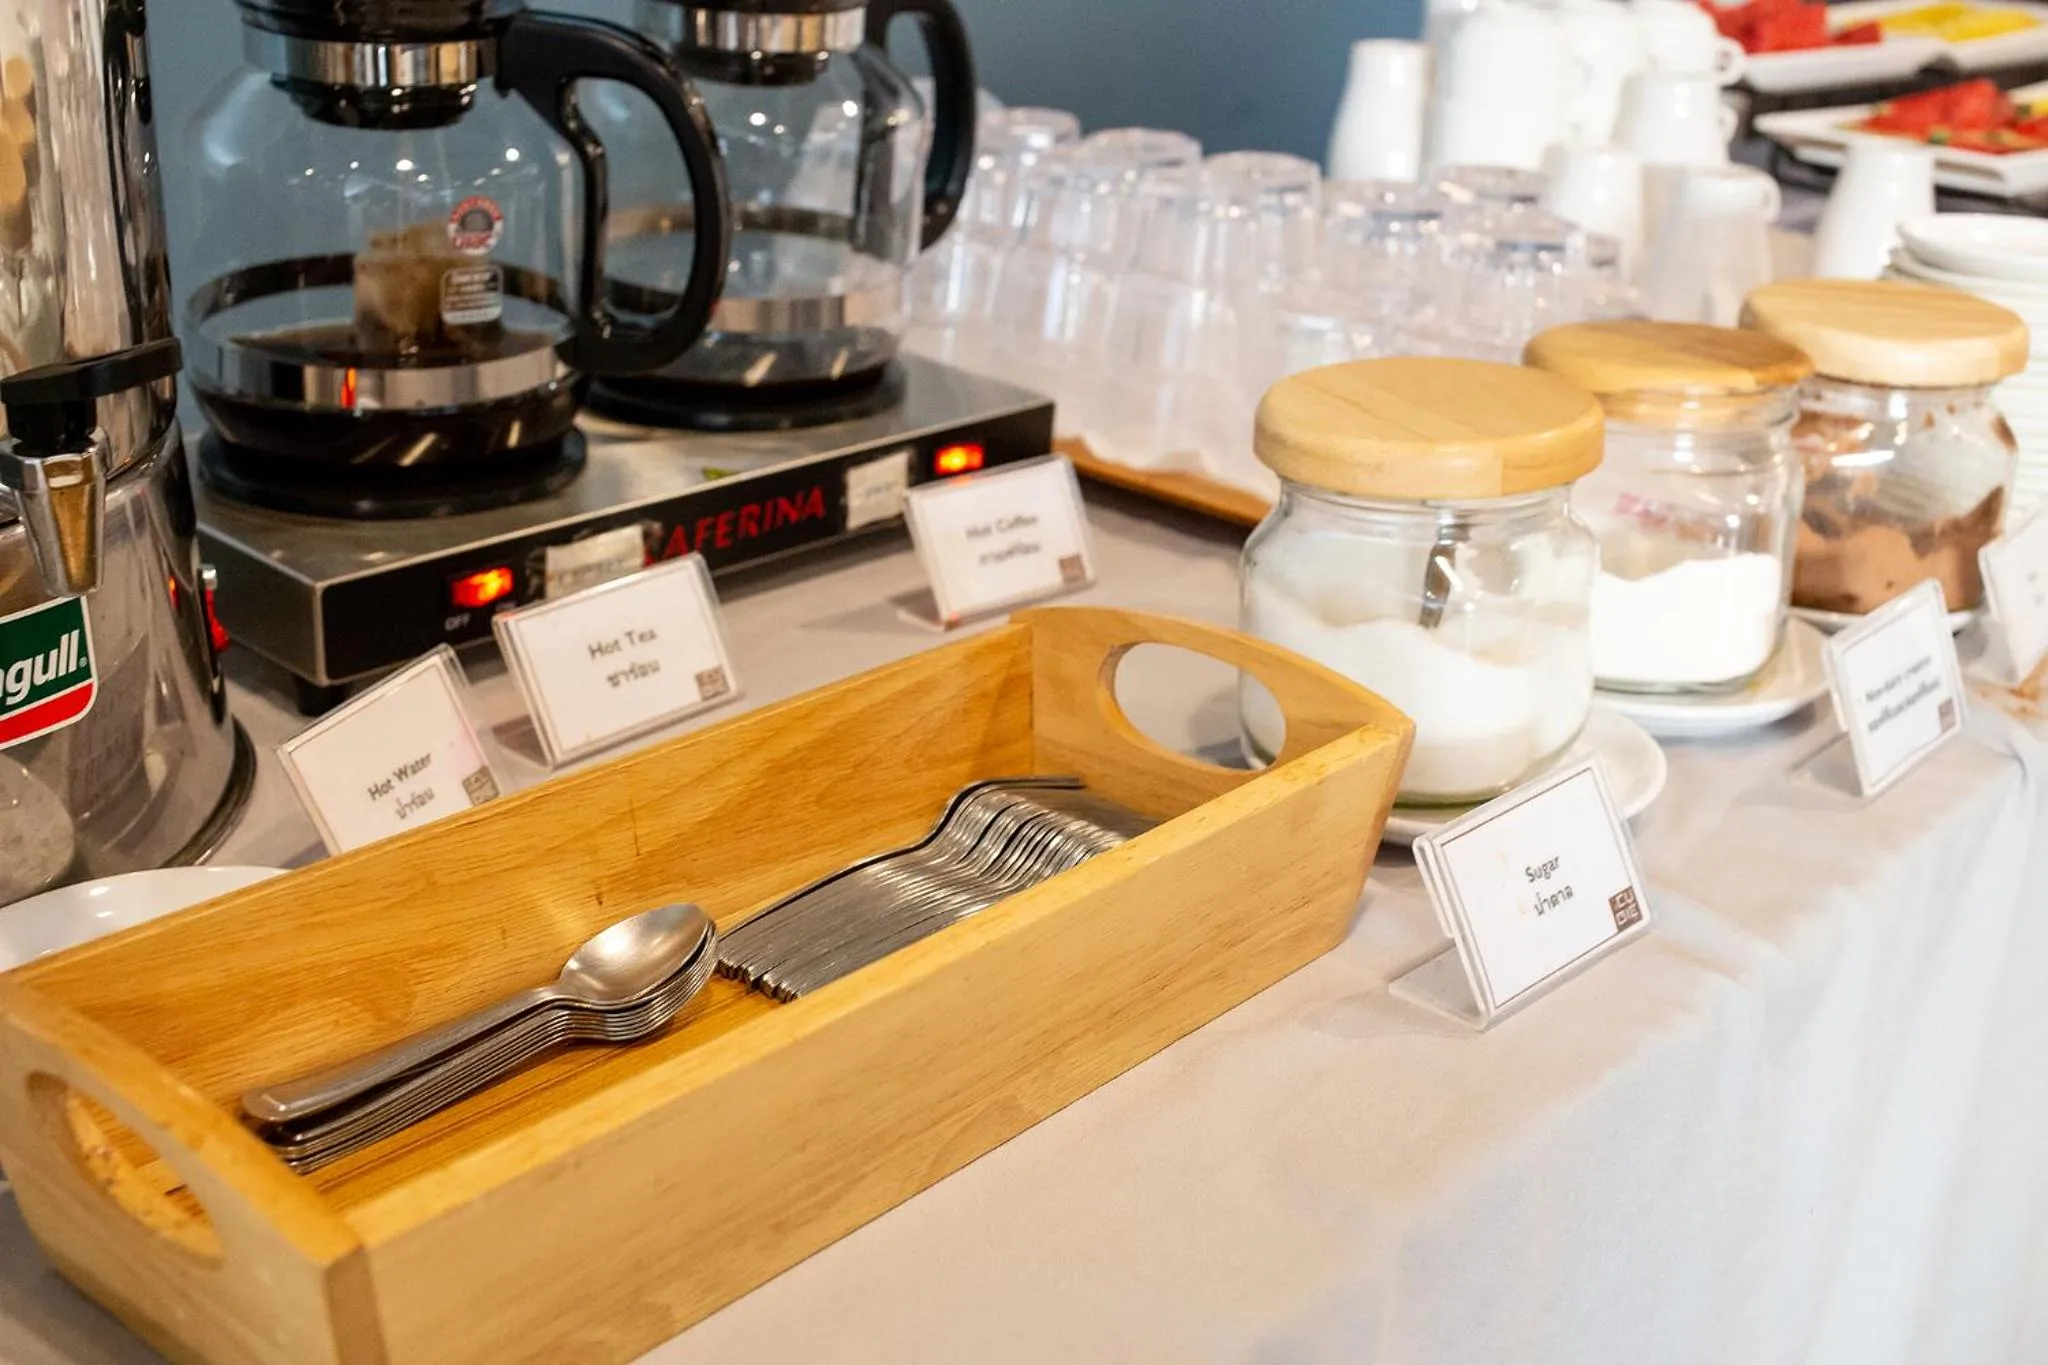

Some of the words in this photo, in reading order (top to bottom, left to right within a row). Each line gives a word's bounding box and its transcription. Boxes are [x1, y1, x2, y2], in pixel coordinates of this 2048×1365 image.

[588, 638, 622, 660] Hot
[624, 627, 658, 647] Tea
[0, 629, 80, 706] gull
[367, 777, 396, 801] Hot
[393, 752, 432, 784] Water
[1525, 855, 1560, 884] Sugar
[1533, 884, 1575, 917] น้ำตาล
